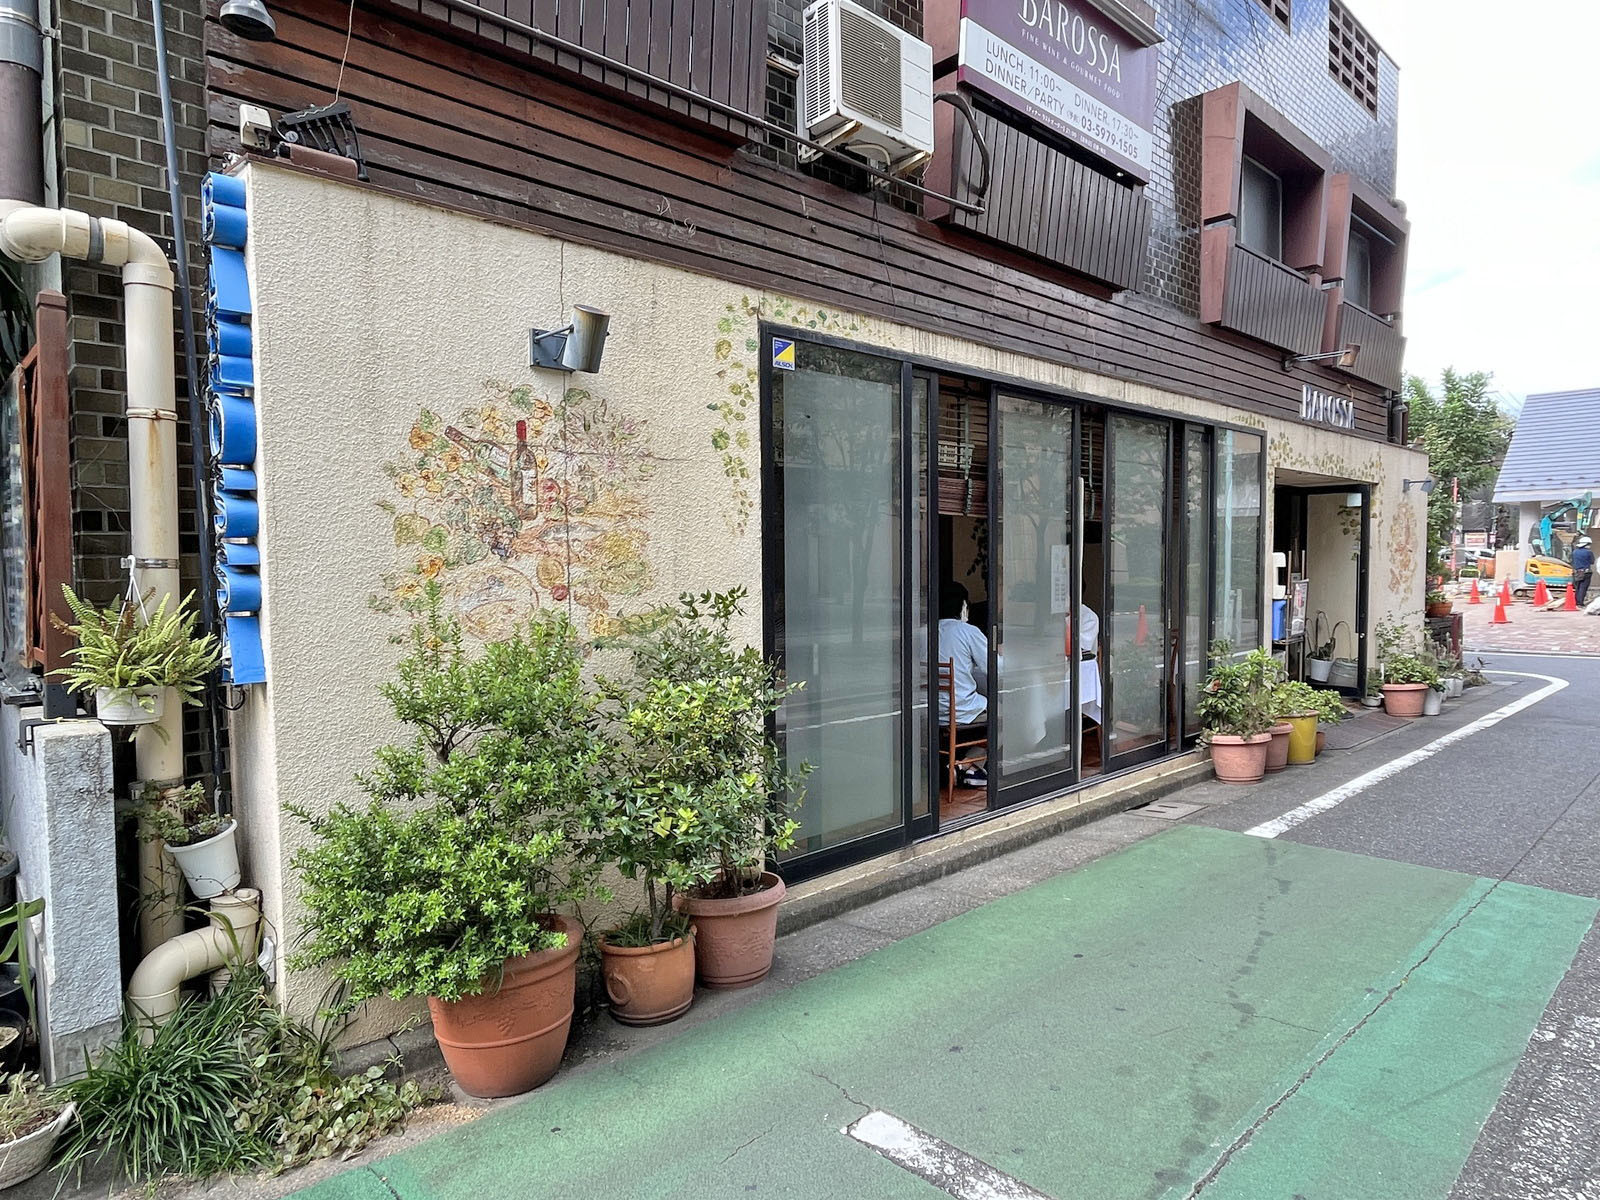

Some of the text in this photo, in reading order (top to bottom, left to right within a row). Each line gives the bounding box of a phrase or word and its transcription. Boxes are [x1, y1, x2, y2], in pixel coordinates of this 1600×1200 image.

[1018, 0, 1120, 84] BAROSSA
[1021, 28, 1039, 46] FINE
[985, 58, 1064, 115] DINNER/PARTY
[1081, 115, 1138, 159] 03-5979-1505
[1302, 384, 1355, 429] BAROSSA
